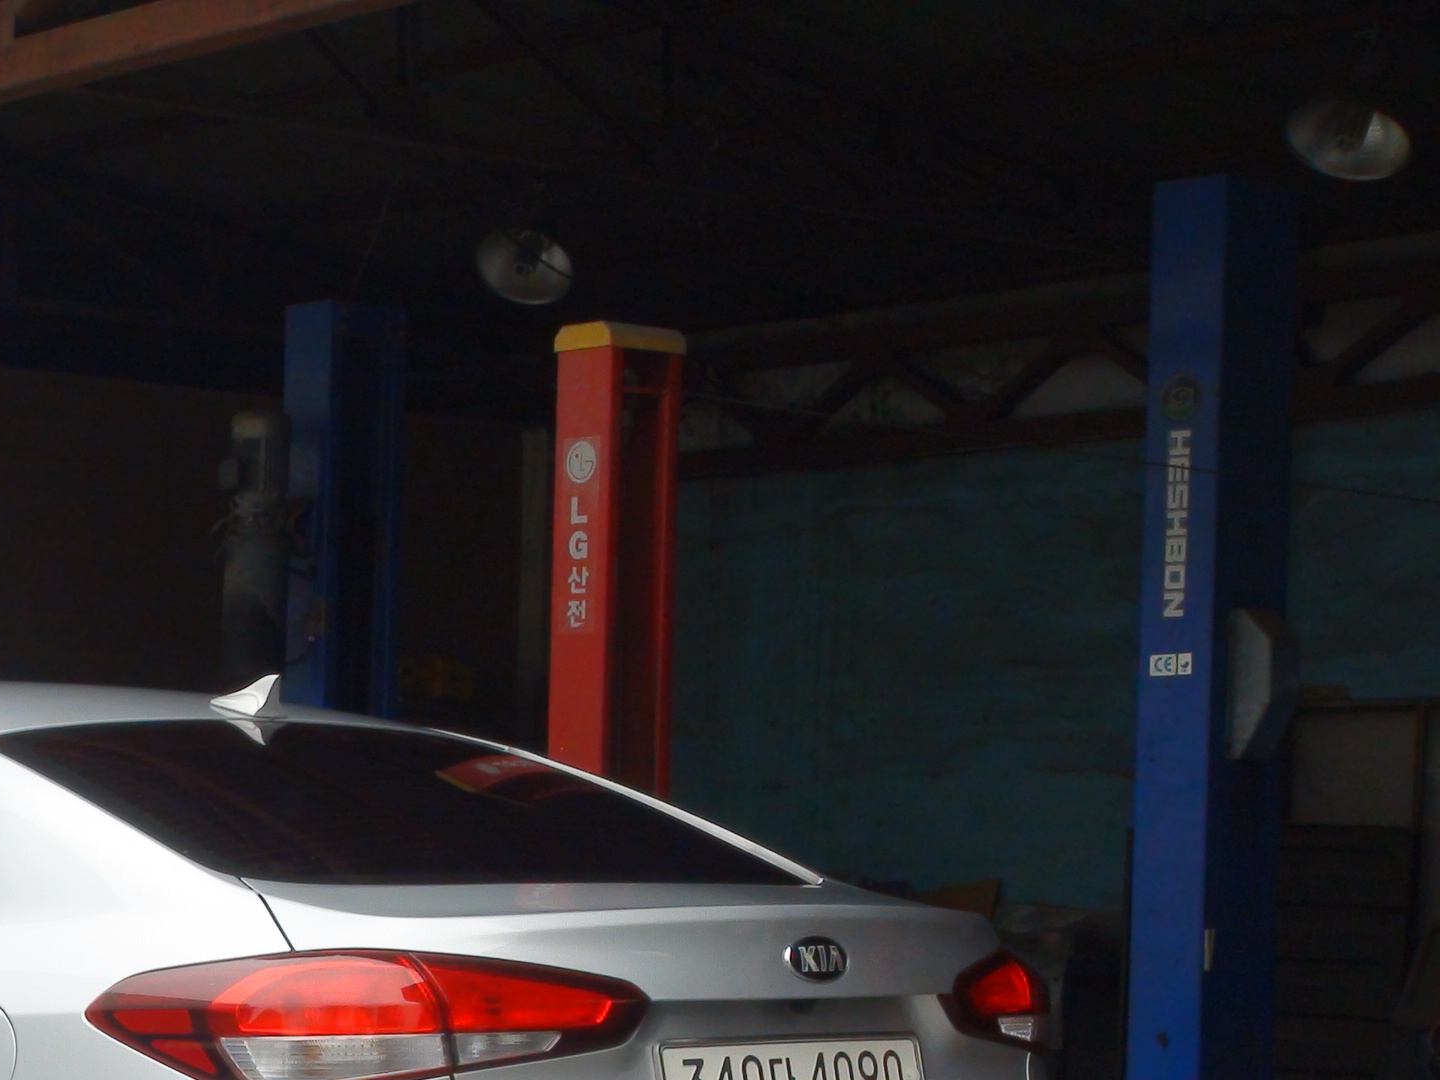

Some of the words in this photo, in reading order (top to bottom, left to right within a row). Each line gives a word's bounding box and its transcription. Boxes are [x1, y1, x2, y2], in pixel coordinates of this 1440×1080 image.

[567, 496, 590, 628] LG산전
[1163, 429, 1192, 618] HESHBON
[798, 945, 843, 972] KIA
